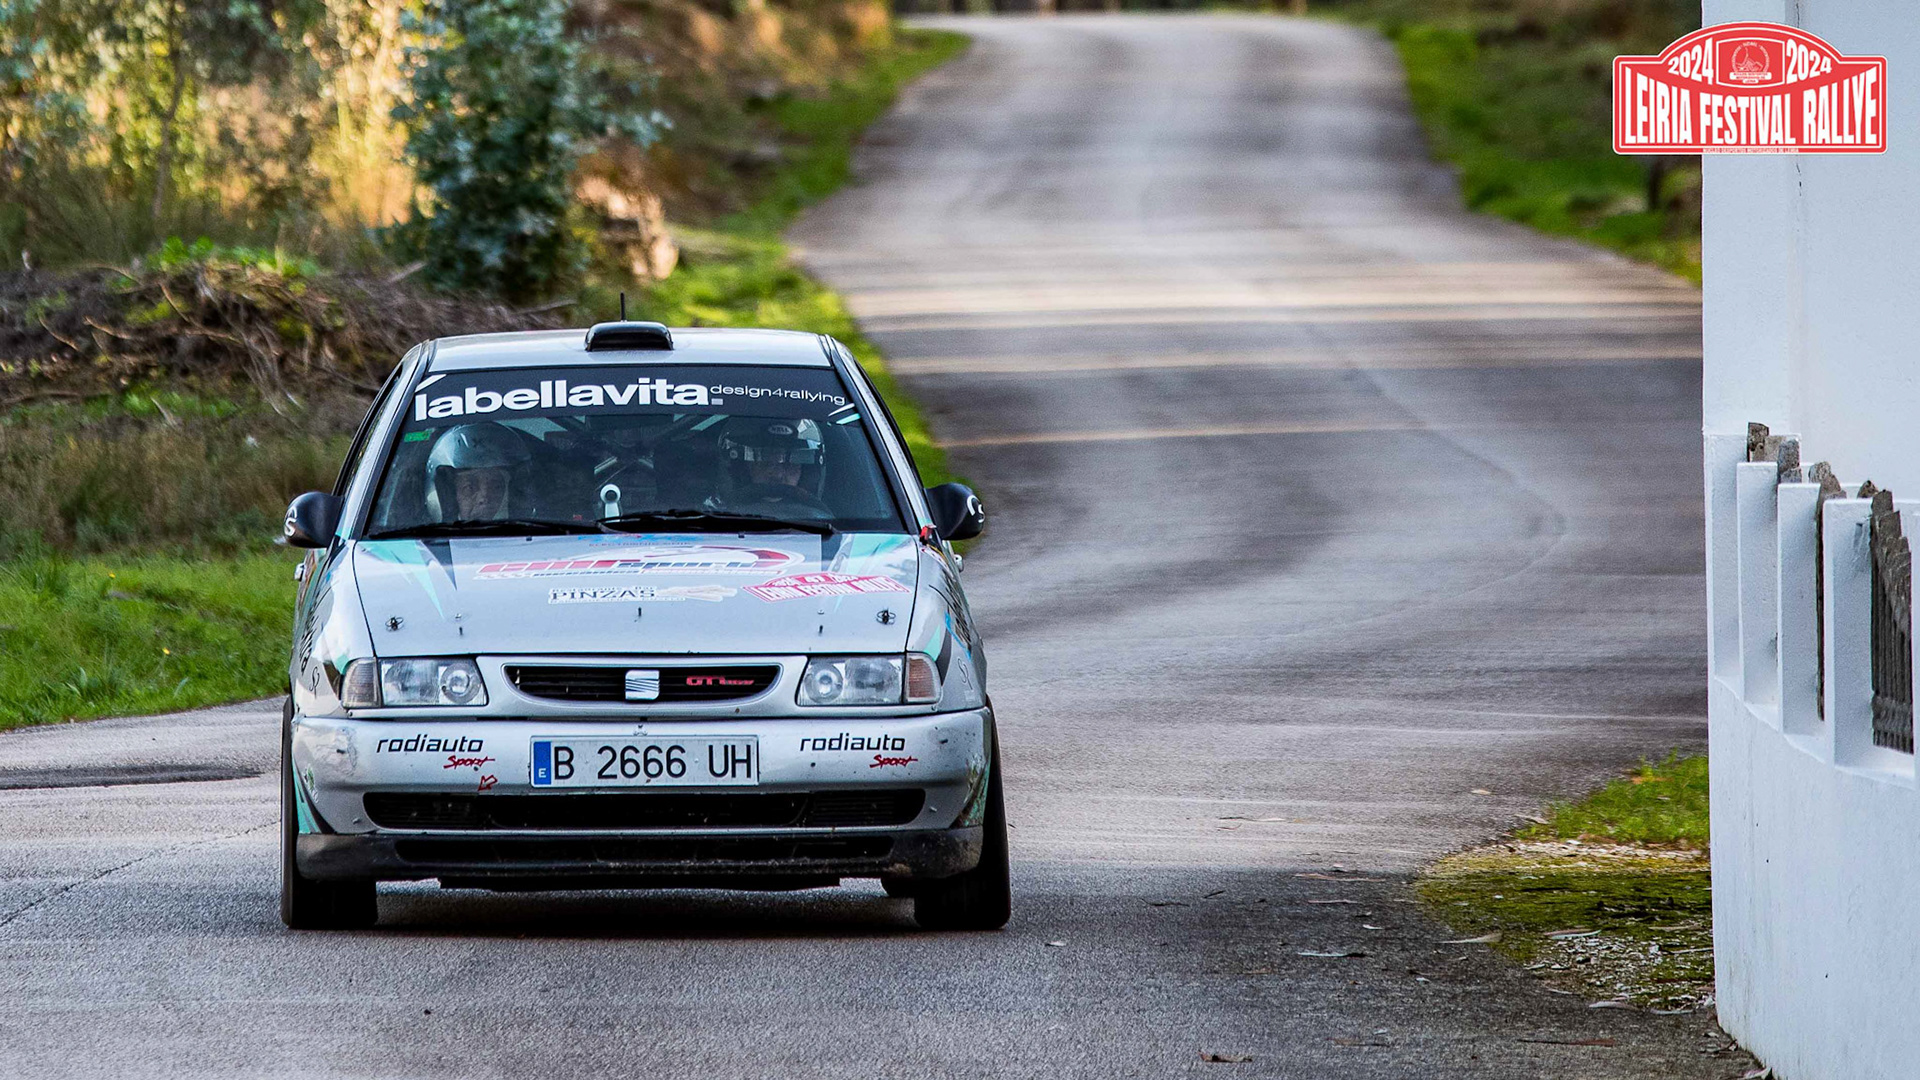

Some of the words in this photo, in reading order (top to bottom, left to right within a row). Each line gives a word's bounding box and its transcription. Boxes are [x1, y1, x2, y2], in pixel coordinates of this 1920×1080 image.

[710, 384, 846, 406] design4rallying
[552, 589, 655, 600] PINZAS
[376, 733, 484, 753] rodiauto
[800, 732, 906, 752] rodiauto
[443, 754, 496, 770] Sport
[538, 768, 547, 778] E
[554, 746, 574, 780] B
[597, 745, 687, 780] 2666
[708, 744, 752, 779] UH
[869, 753, 919, 769] Sport
